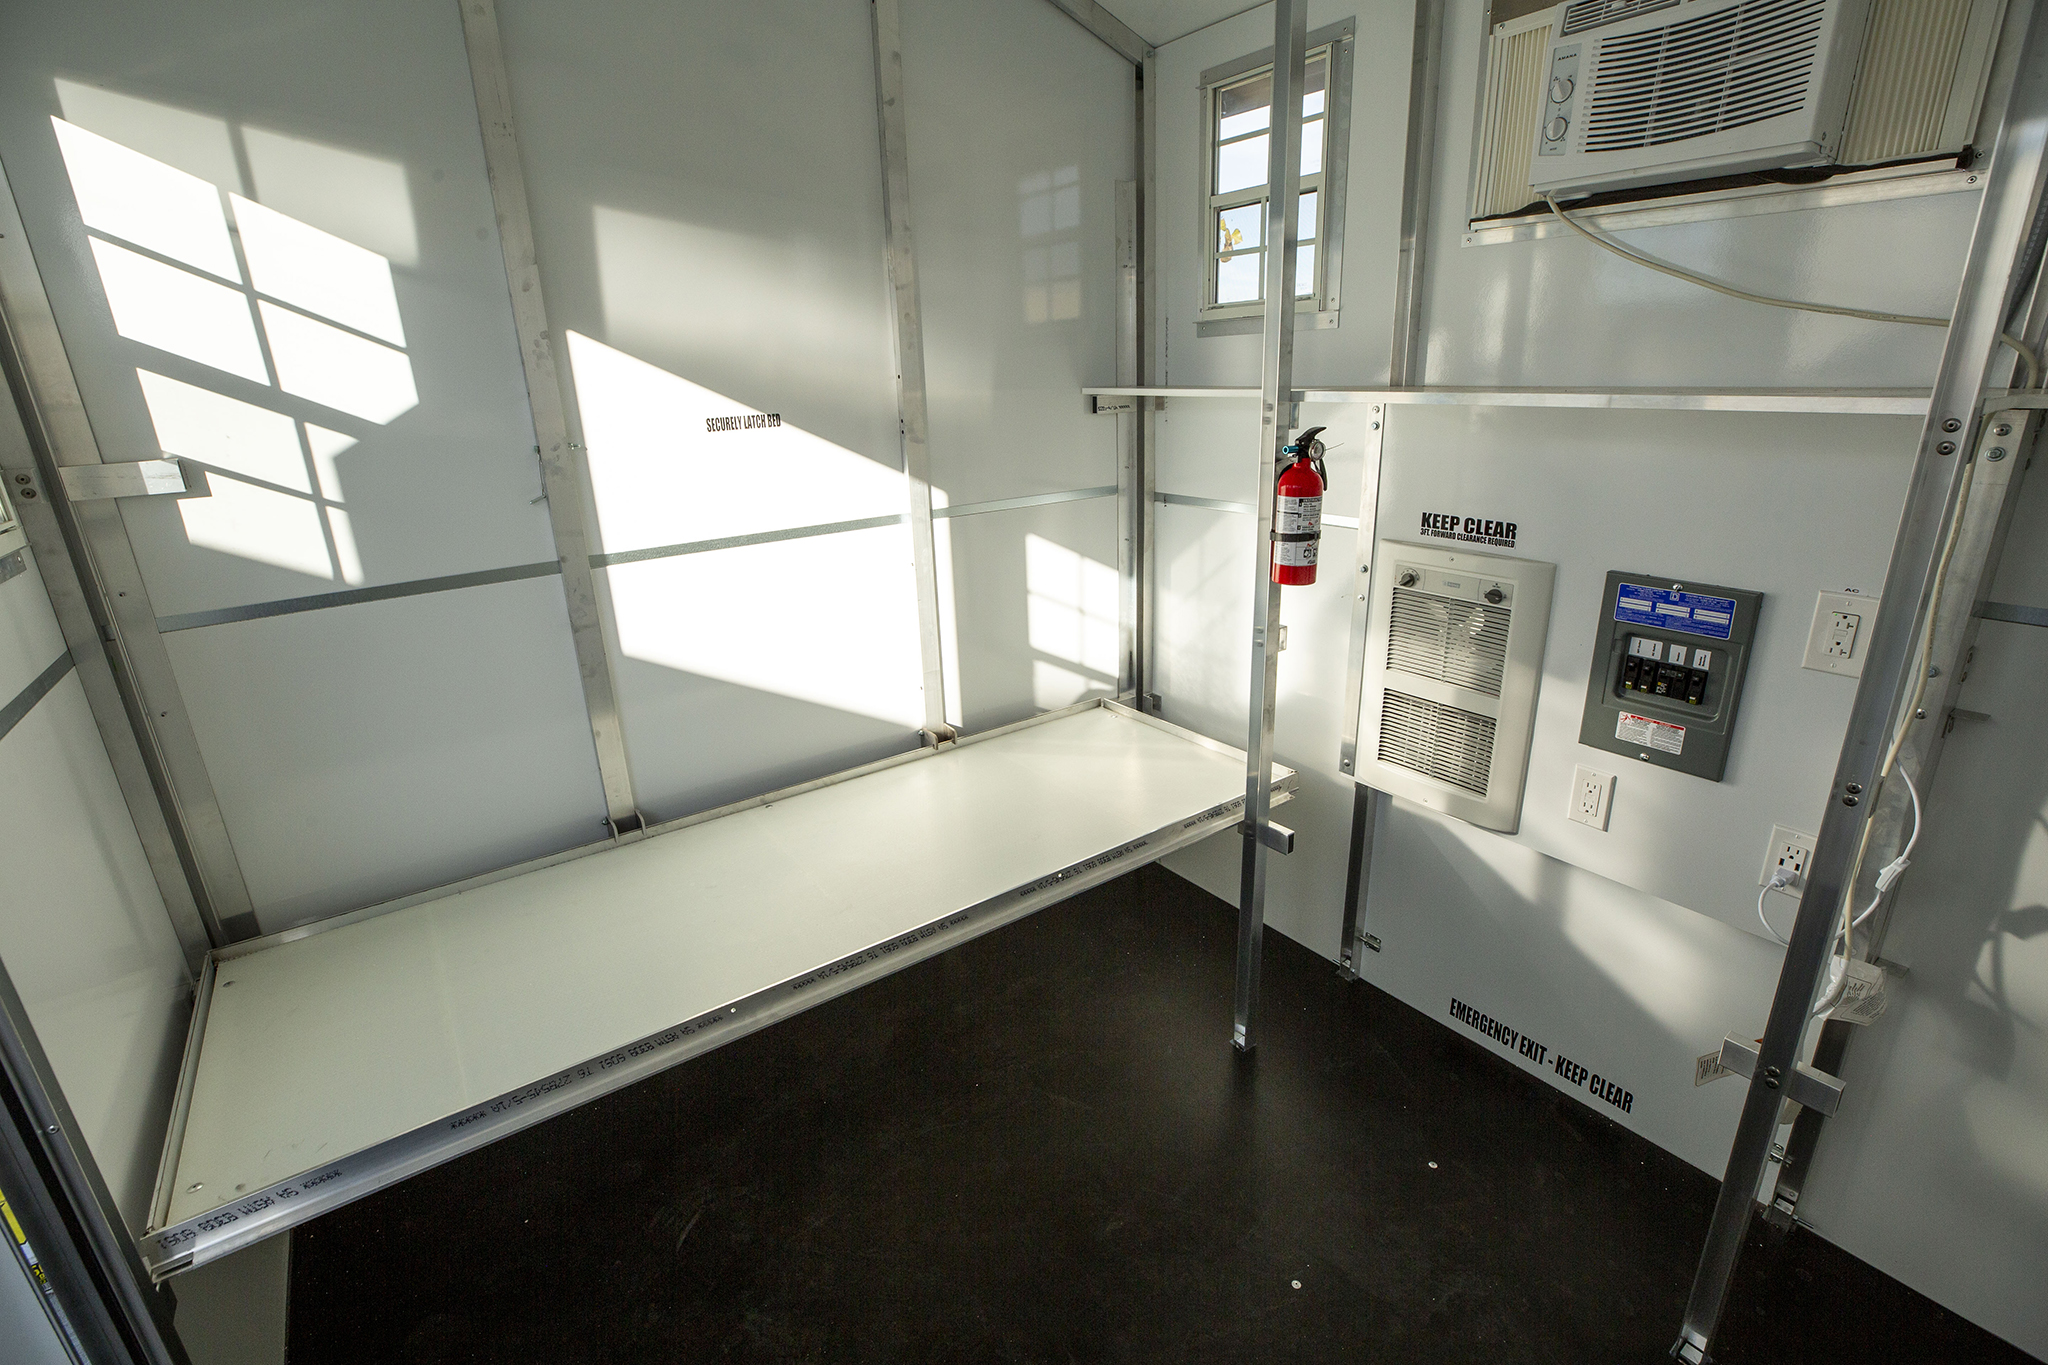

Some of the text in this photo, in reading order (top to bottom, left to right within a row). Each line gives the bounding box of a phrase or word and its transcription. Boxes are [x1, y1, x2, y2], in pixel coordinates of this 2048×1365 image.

[1558, 53, 1577, 61] AMANA
[706, 413, 781, 432] SECURELY LATCH BED
[1421, 512, 1518, 539] KEEP CLEAR
[1431, 529, 1456, 539] FORWARD
[1457, 533, 1487, 544] CLEARANCE
[1487, 537, 1516, 548] REQUIRED
[1450, 997, 1519, 1050] EMERGENCY
[1518, 1035, 1548, 1066] EXIT
[1554, 1054, 1589, 1087] KEEP
[1589, 1074, 1634, 1115] CLEAR
